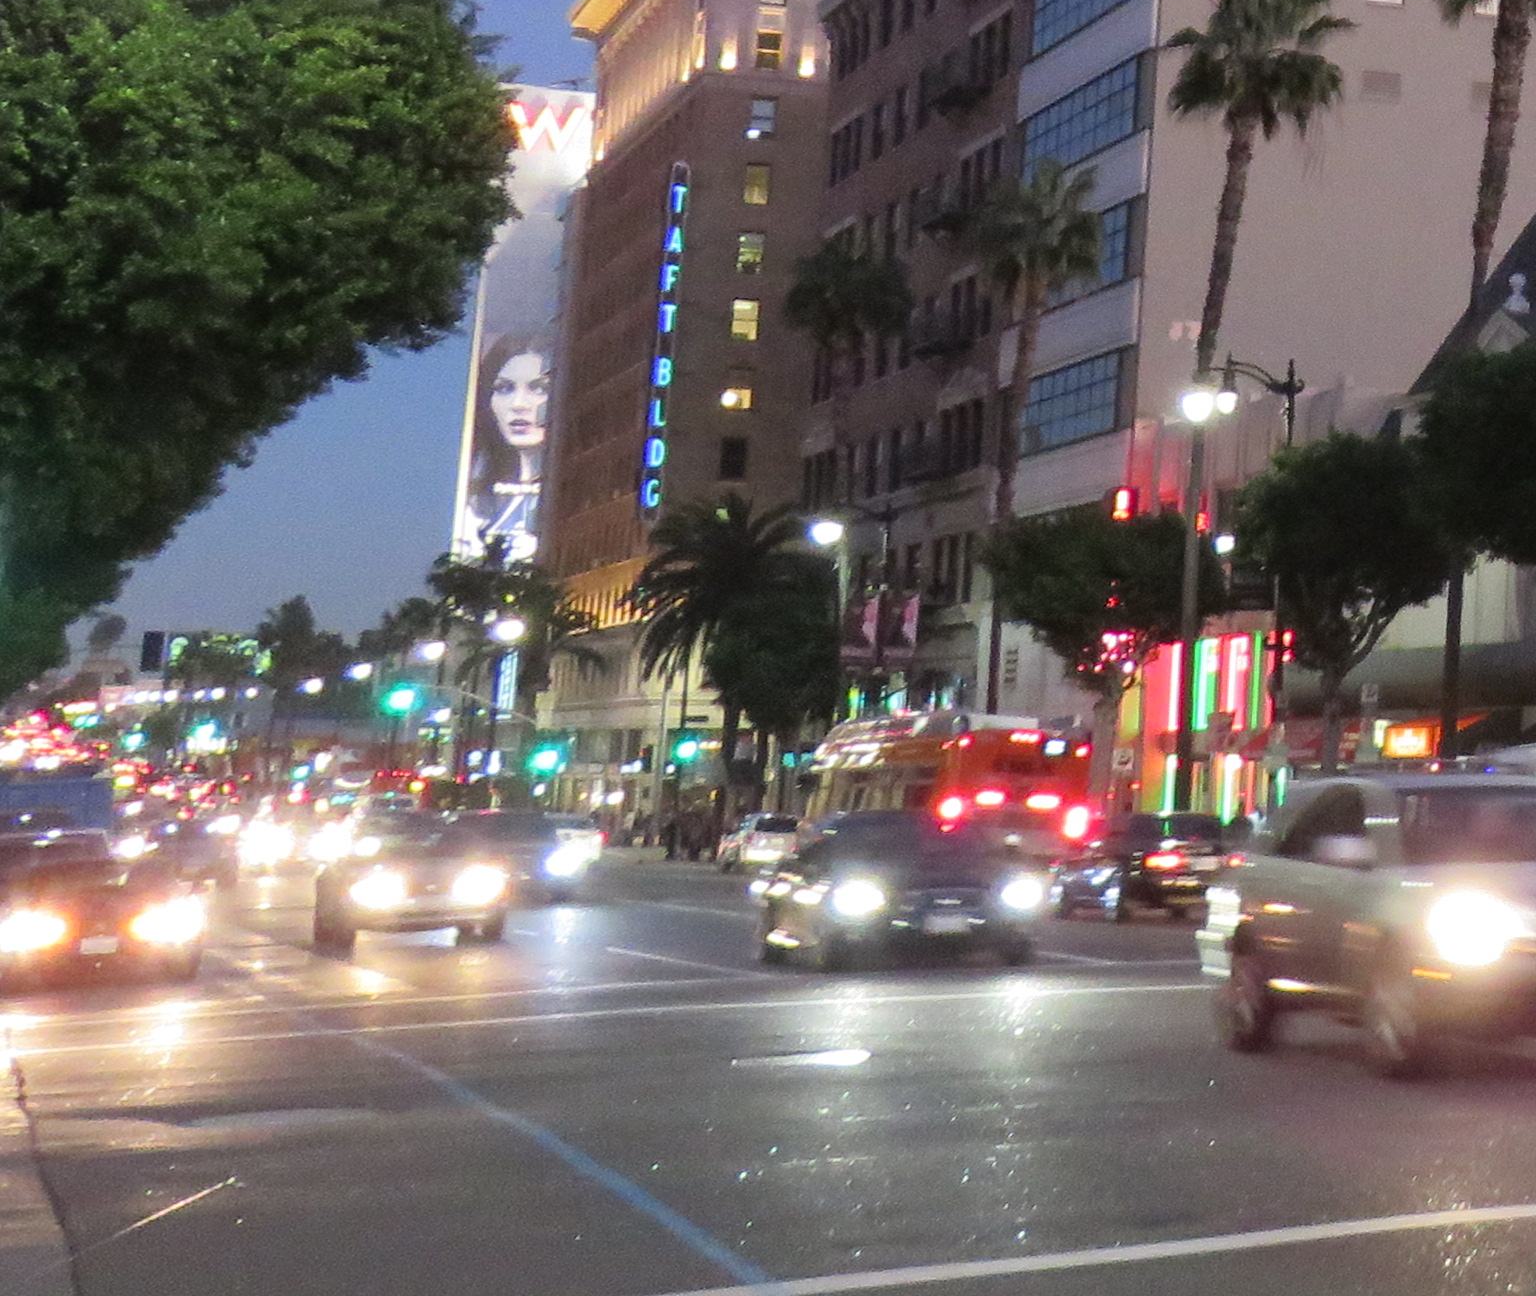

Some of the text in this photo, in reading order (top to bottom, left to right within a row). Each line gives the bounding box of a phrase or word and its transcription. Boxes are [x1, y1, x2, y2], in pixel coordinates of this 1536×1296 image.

[509, 100, 586, 154] W
[640, 184, 689, 508] TAFT BLDG
